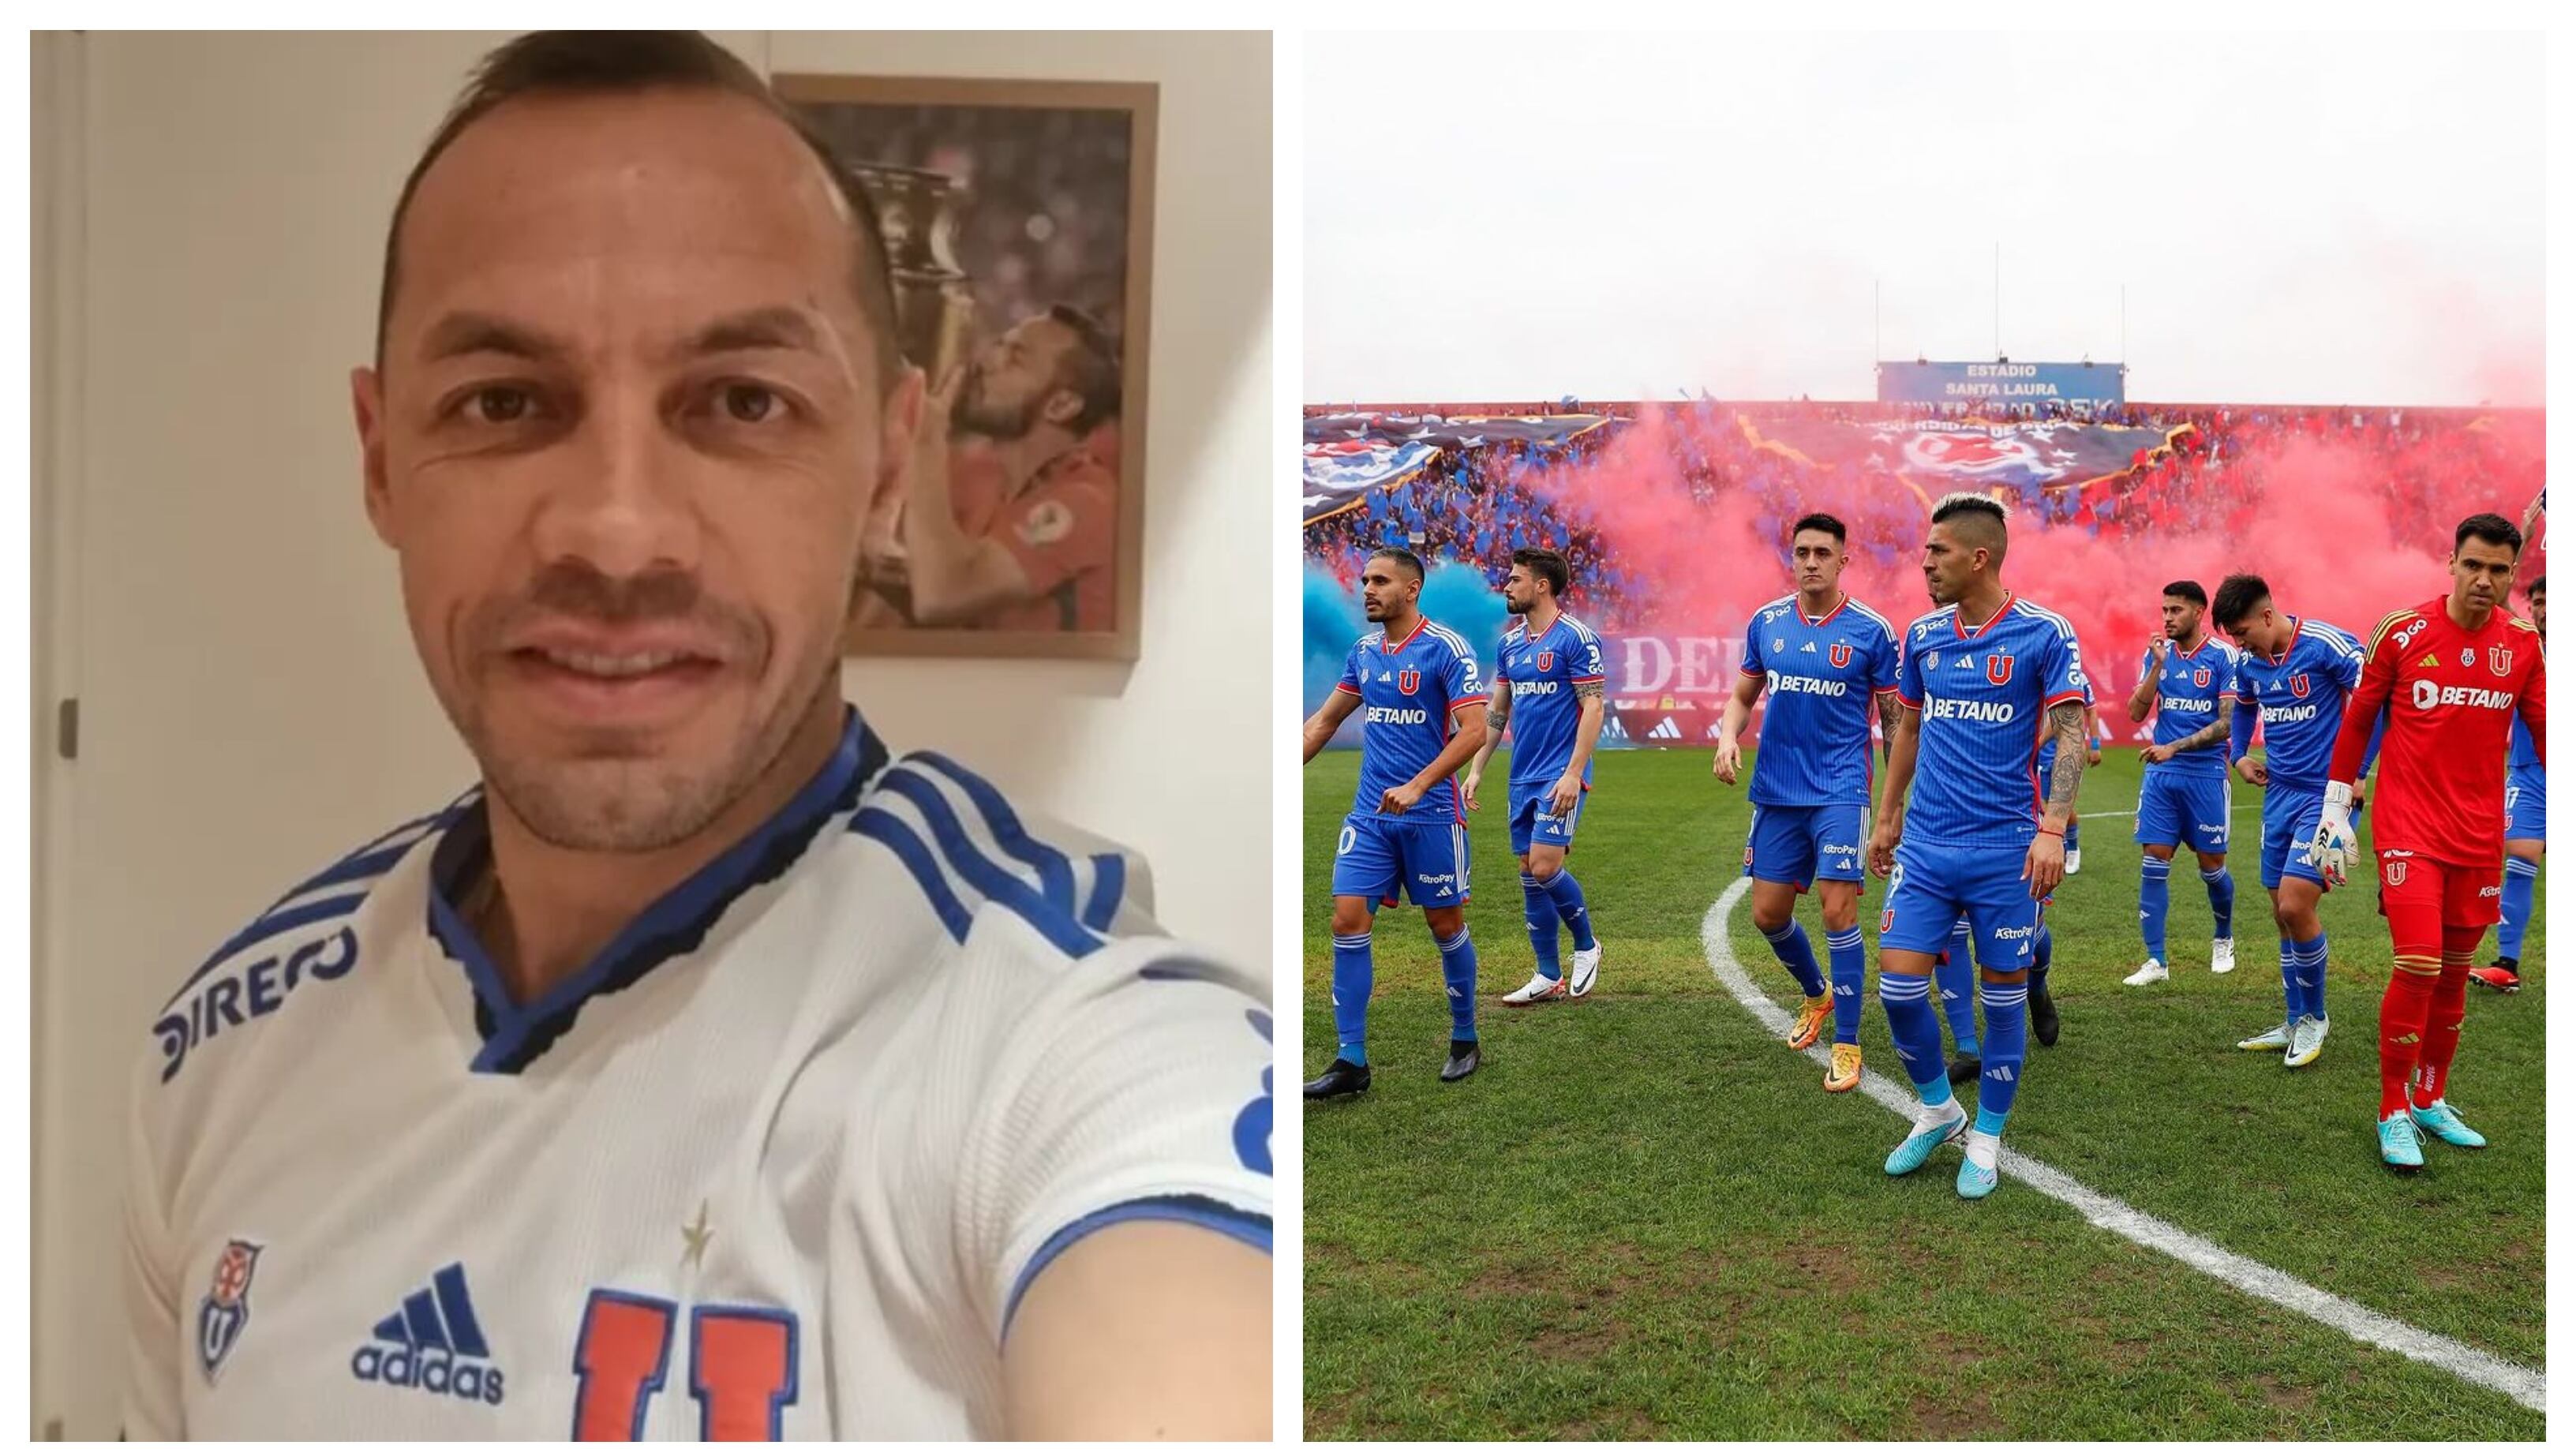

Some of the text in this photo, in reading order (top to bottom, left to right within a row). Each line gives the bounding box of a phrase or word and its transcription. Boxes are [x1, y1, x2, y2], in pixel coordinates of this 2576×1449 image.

[1968, 365, 2037, 377] ESTADIO
[1945, 384, 2057, 395] SANTA LAURA
[1537, 652, 1554, 672] U
[1829, 644, 1853, 668] U
[1986, 655, 2014, 686] U
[2194, 668, 2211, 688] U
[1398, 671, 1421, 695] U
[1516, 681, 1558, 695] BETANO
[1780, 675, 1846, 697] BETANO
[2289, 673, 2311, 699] U
[2163, 698, 2212, 713] BETANO
[2439, 686, 2514, 710] BETANO
[1367, 706, 1426, 725] BETANO
[1934, 698, 2013, 722] BETANO
[2263, 705, 2316, 722] BETANO
[2387, 862, 2406, 886] U
[352, 1342, 504, 1406] adidas
